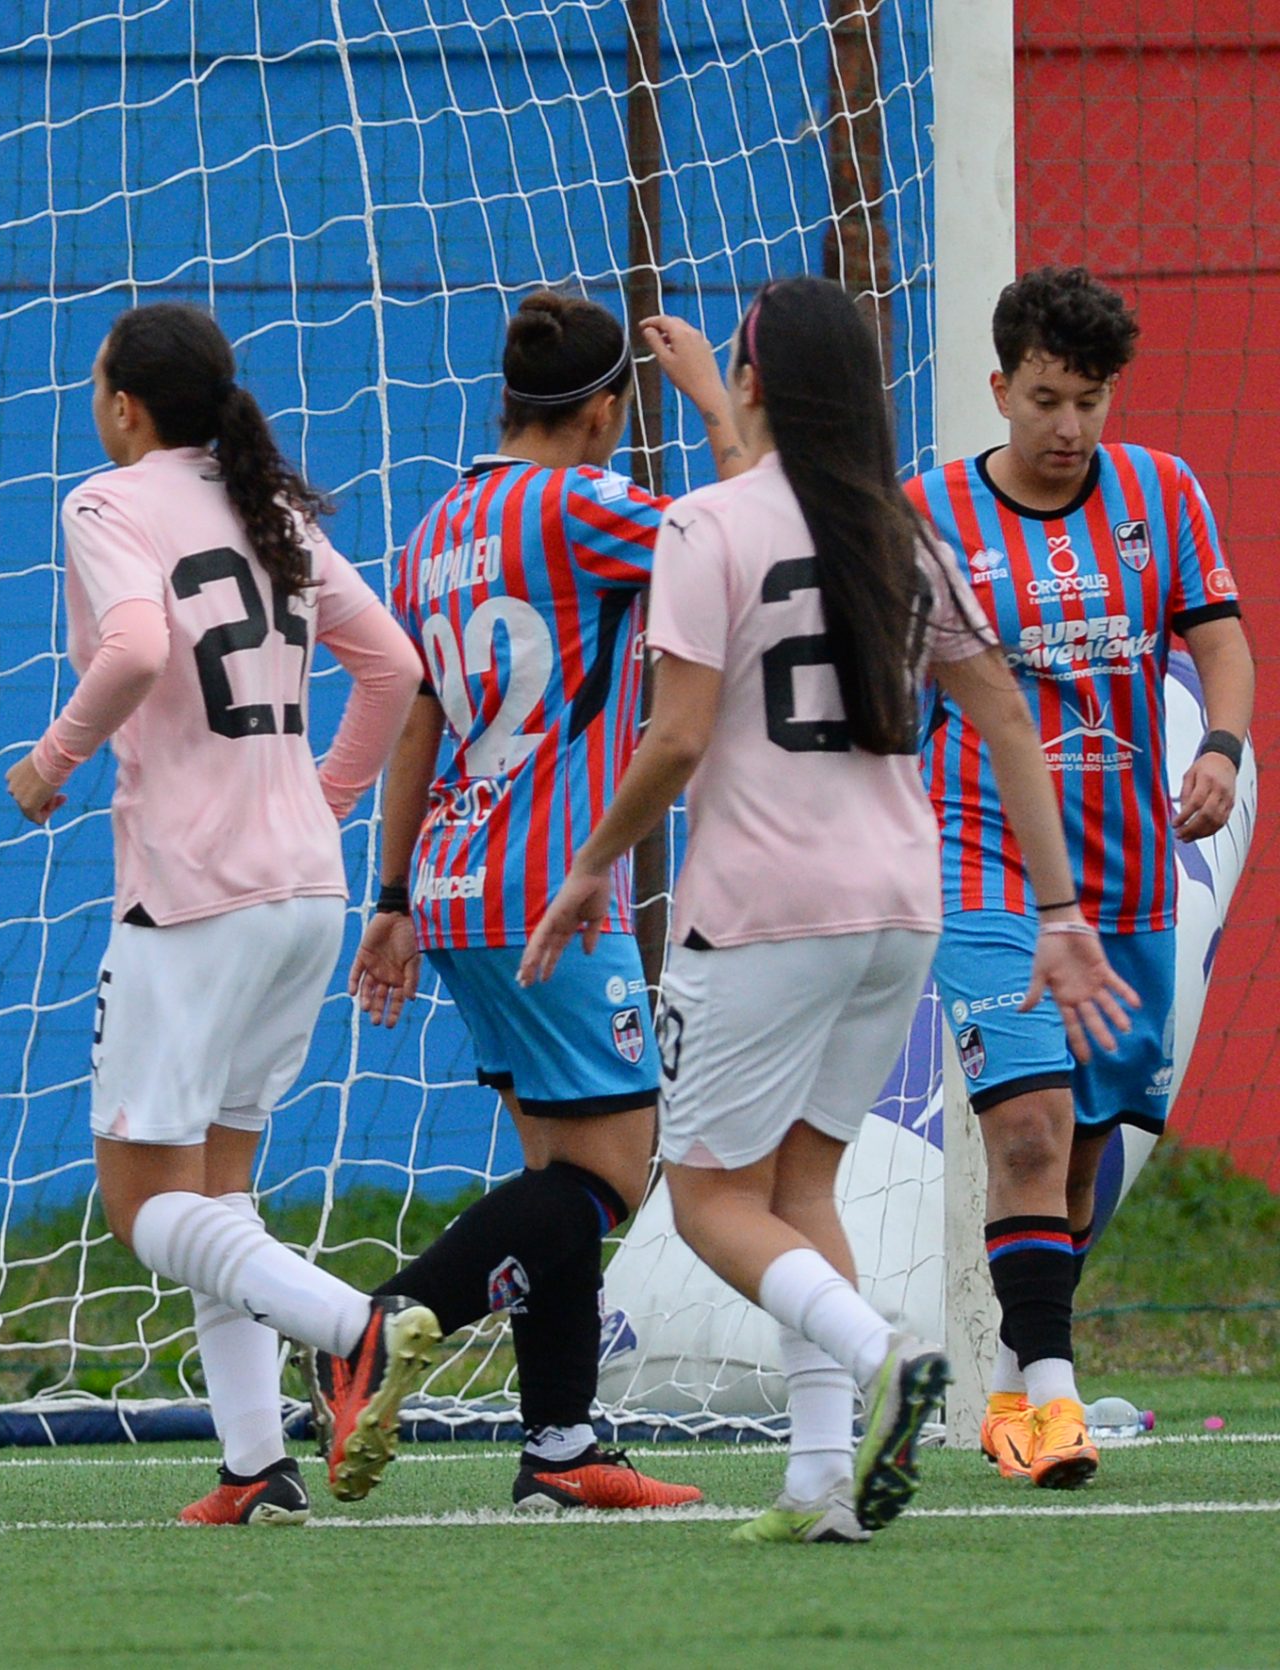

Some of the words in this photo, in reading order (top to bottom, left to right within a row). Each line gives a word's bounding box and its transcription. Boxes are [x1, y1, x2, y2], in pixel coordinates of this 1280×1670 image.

[419, 534, 502, 604] PAPALEO
[1005, 630, 1160, 669] onveniente
[1019, 615, 1130, 650] SUPER
[1045, 752, 1084, 763] UNIVIA
